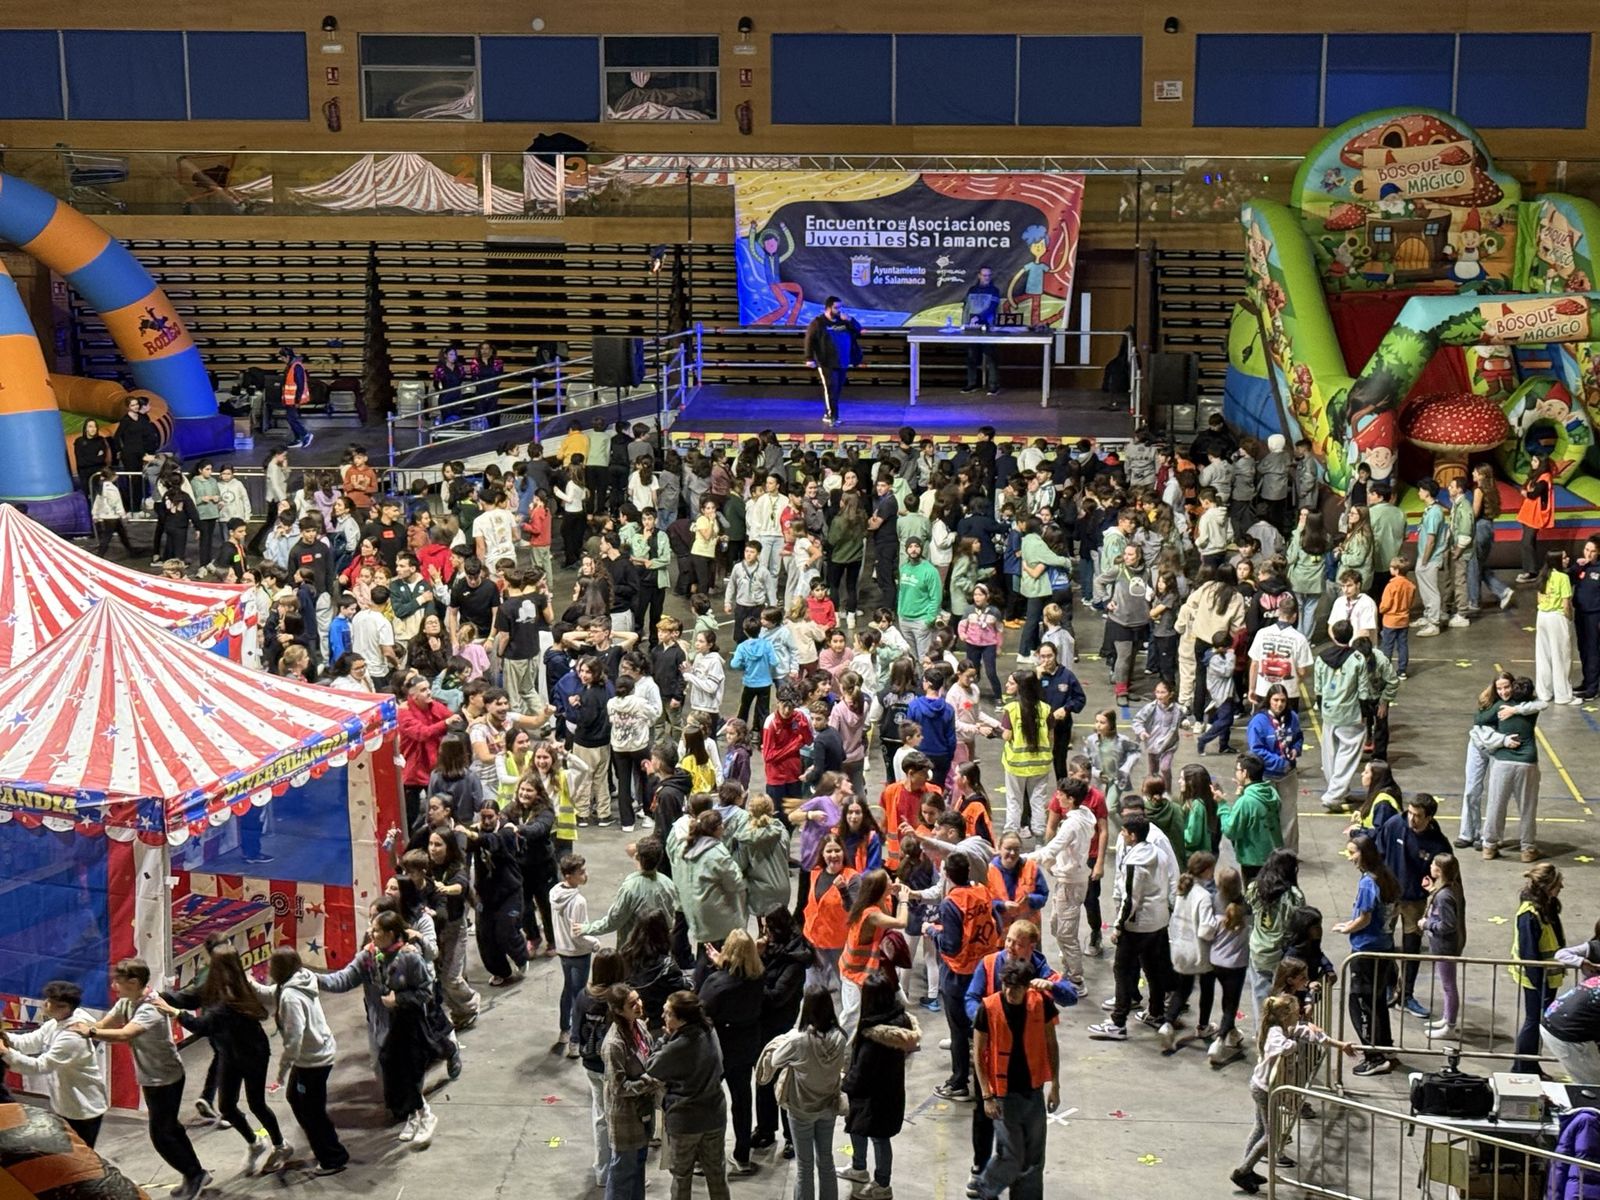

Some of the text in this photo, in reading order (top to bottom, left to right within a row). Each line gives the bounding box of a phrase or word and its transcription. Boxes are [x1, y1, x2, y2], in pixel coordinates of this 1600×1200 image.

[1377, 157, 1441, 182] BOSQUE
[805, 214, 897, 231] Encuentro
[908, 216, 1011, 232] Asociaciones
[806, 231, 1011, 248] Juveniles Salamanca
[873, 265, 926, 276] Ayuntamiento
[873, 276, 926, 285] de Salamanca
[1497, 307, 1557, 334] BOSQUE
[0, 786, 79, 815] ANDIA
